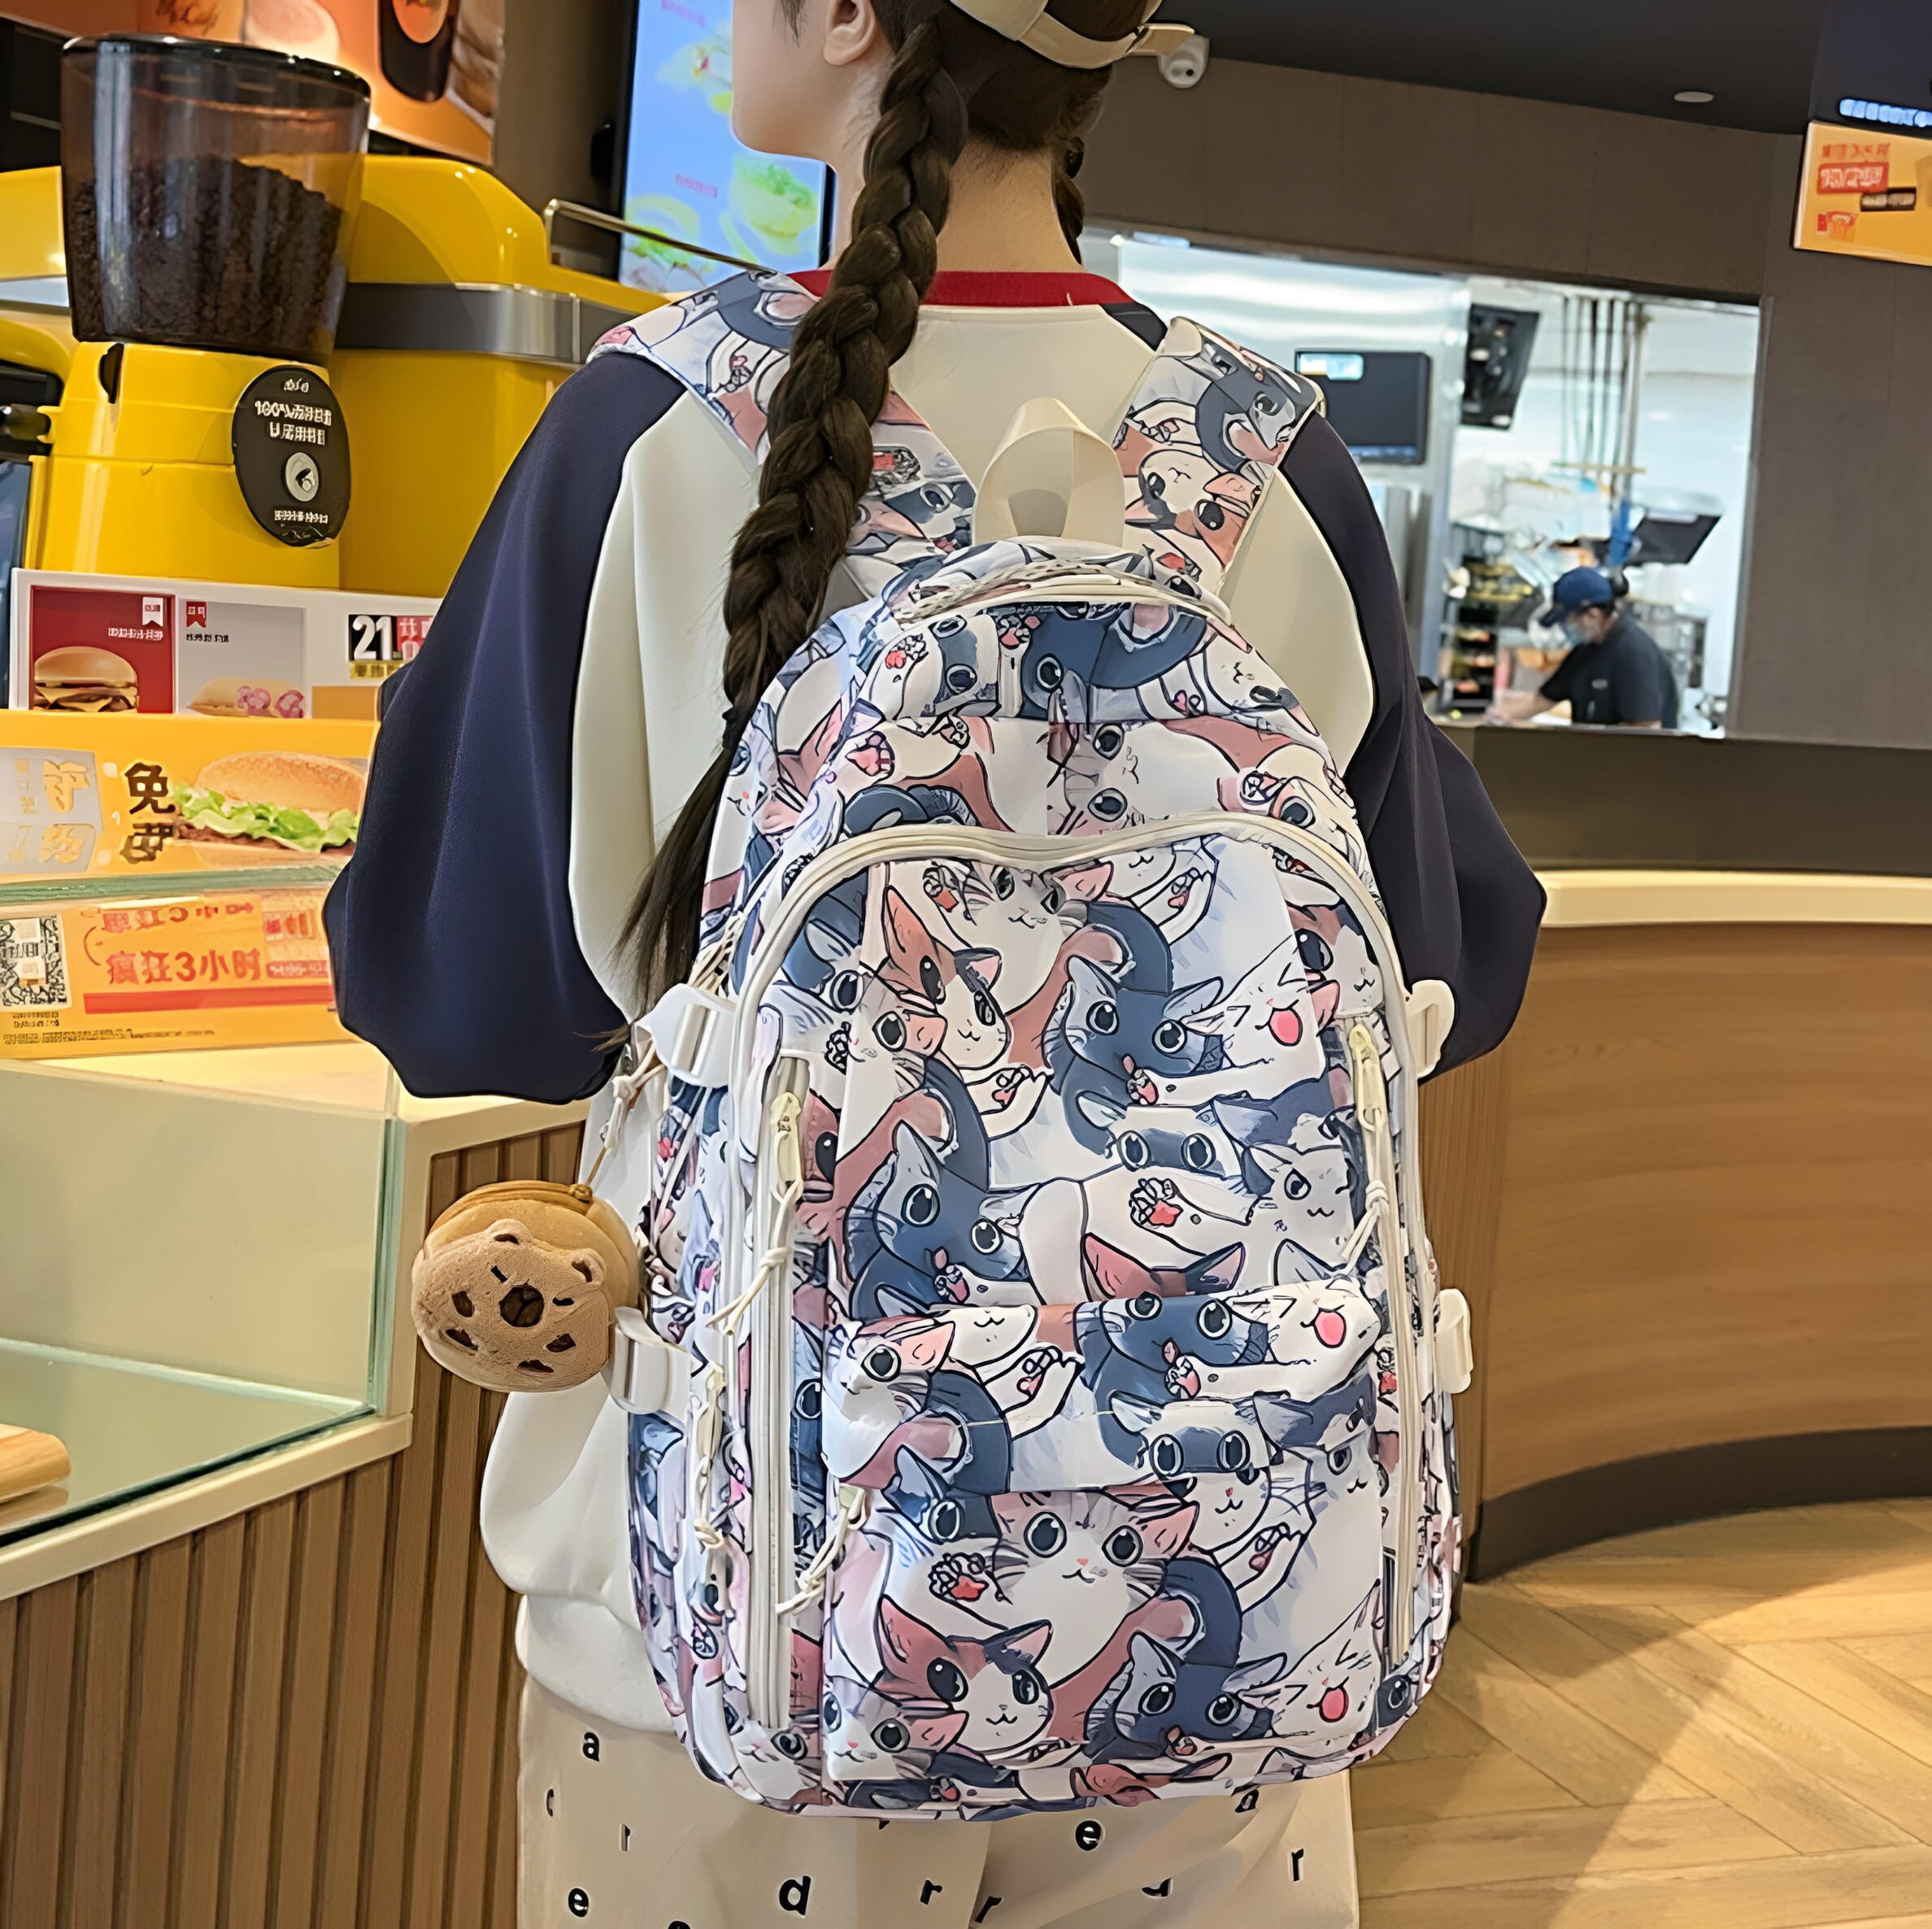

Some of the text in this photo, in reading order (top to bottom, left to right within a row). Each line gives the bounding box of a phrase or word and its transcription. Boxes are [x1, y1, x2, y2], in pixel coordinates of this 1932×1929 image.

[106, 947, 261, 985] 疯狂3小时
[582, 1731, 600, 1762] a
[1075, 1820, 1102, 1852] e
[568, 1888, 590, 1918] e
[779, 1875, 812, 1916] d
[920, 1879, 942, 1905] r
